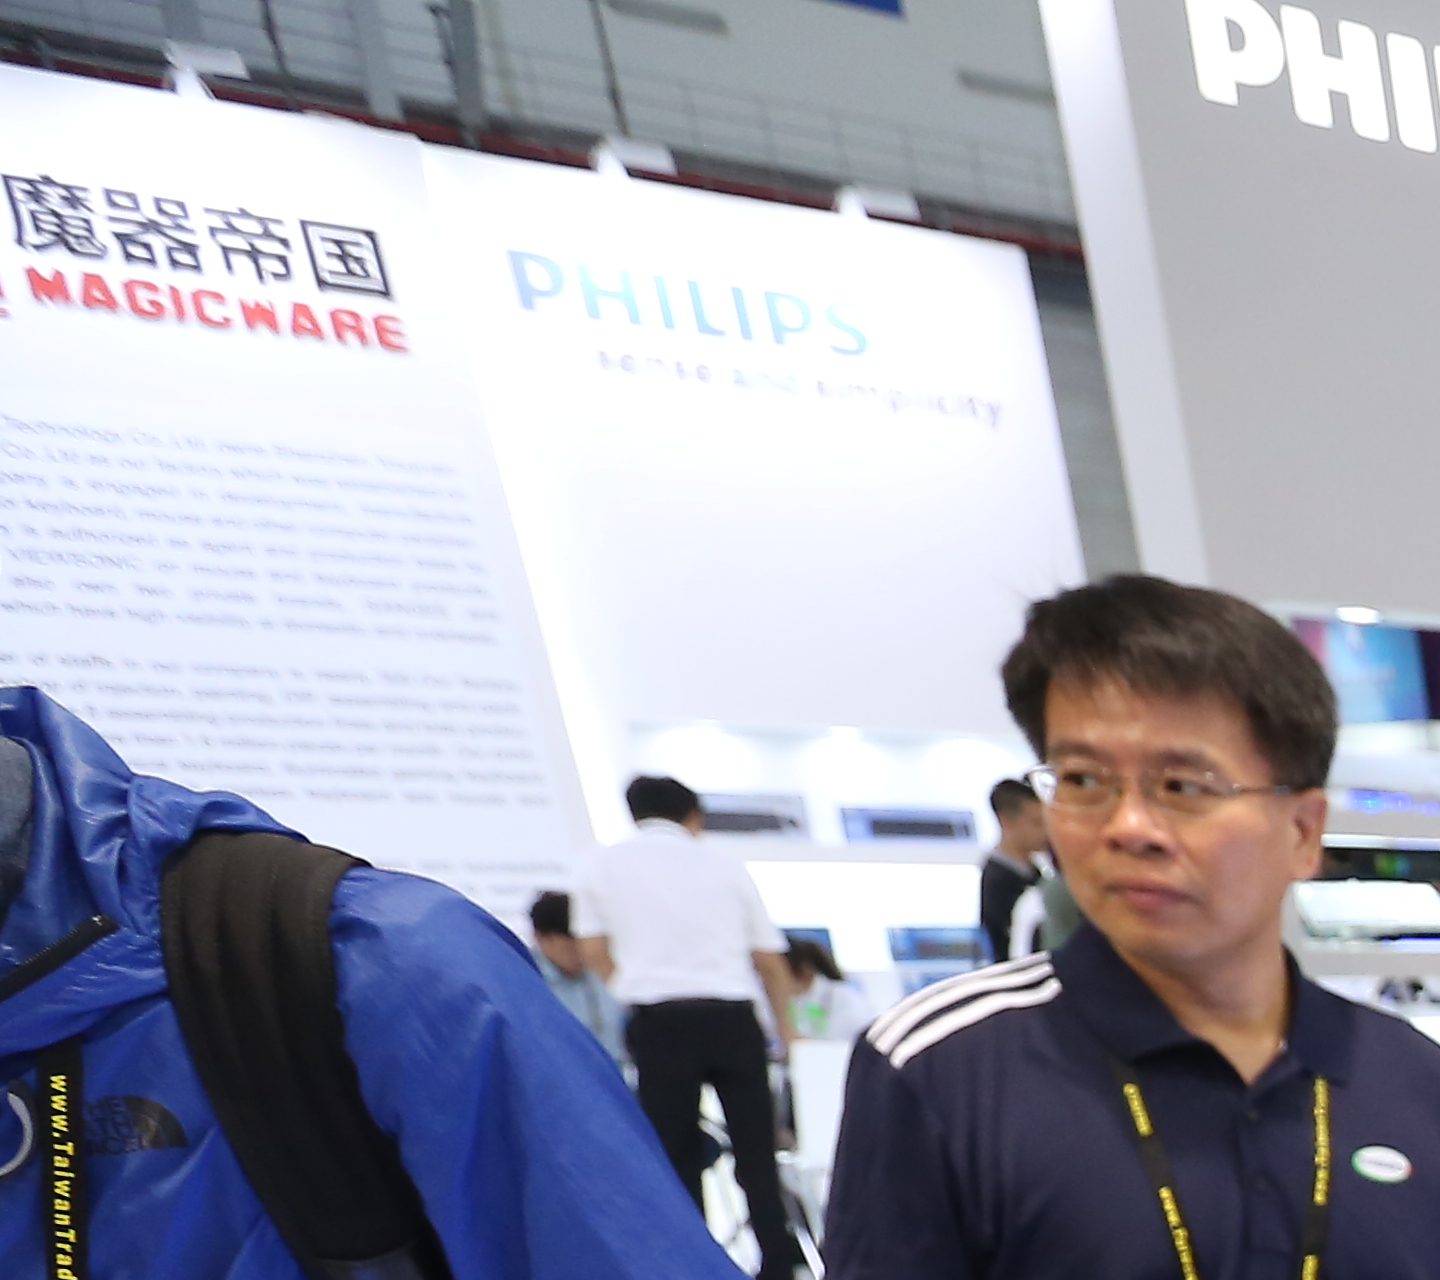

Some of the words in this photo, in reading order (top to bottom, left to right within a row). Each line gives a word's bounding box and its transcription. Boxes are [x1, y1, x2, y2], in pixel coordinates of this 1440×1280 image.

[1, 173, 391, 301] 魔器帝国
[24, 265, 412, 353] MAGICWARE
[506, 249, 869, 358] PHILIPS
